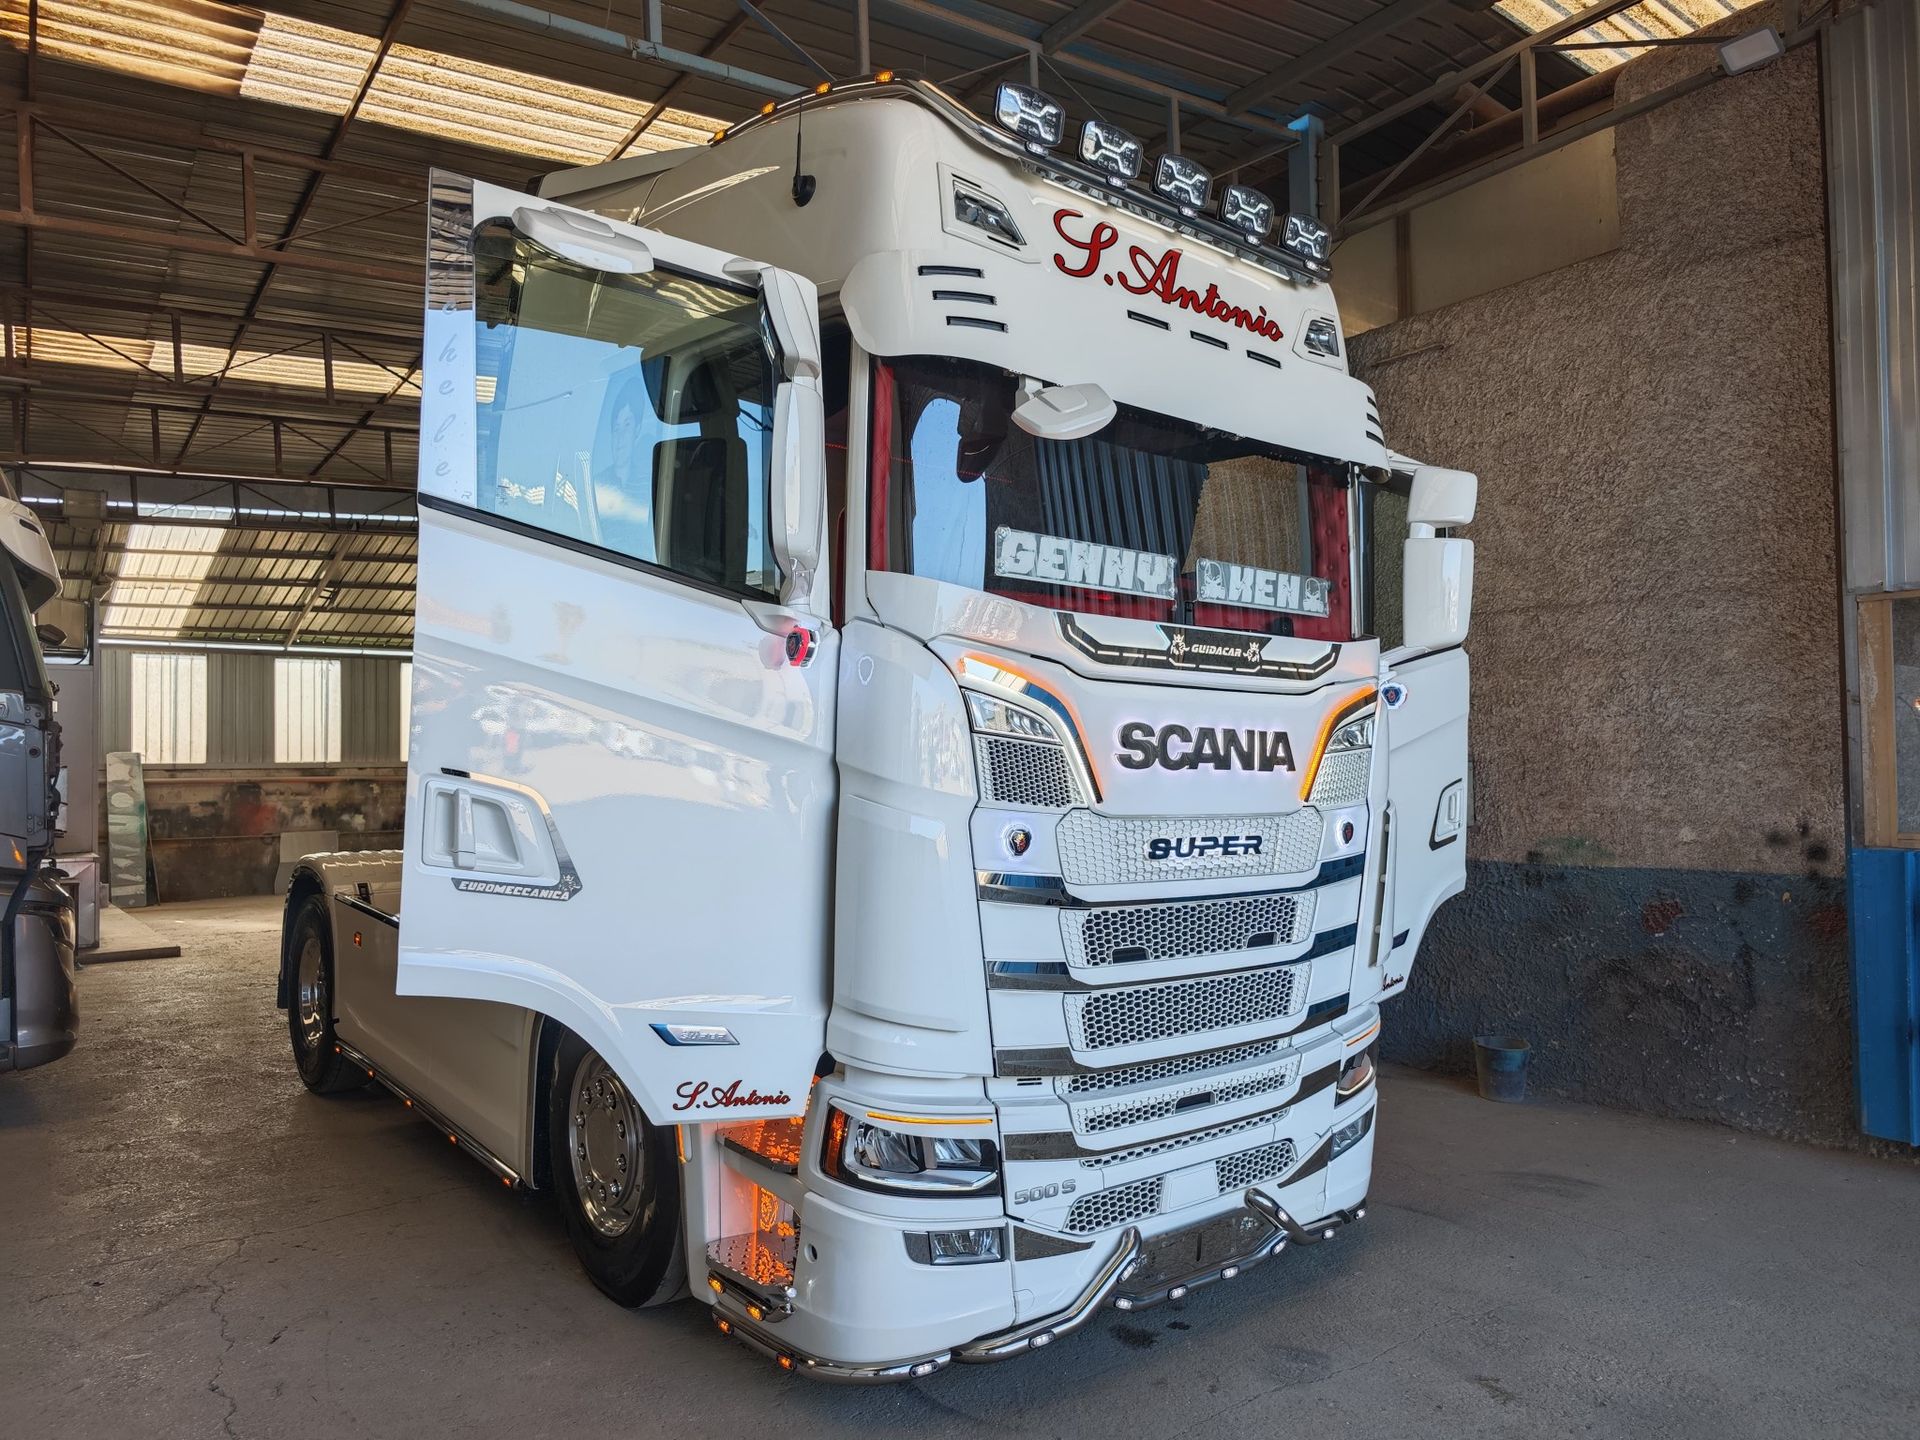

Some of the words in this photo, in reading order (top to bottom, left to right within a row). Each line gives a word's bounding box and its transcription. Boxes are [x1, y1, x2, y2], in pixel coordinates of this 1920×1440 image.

[1001, 532, 1168, 592] GENNY
[1229, 565, 1301, 609] KEN
[1191, 643, 1242, 657] GUIDACAR
[1115, 721, 1296, 771] SCANIA
[1148, 835, 1263, 860] SUPER
[459, 880, 570, 900] EUROMECCANICA
